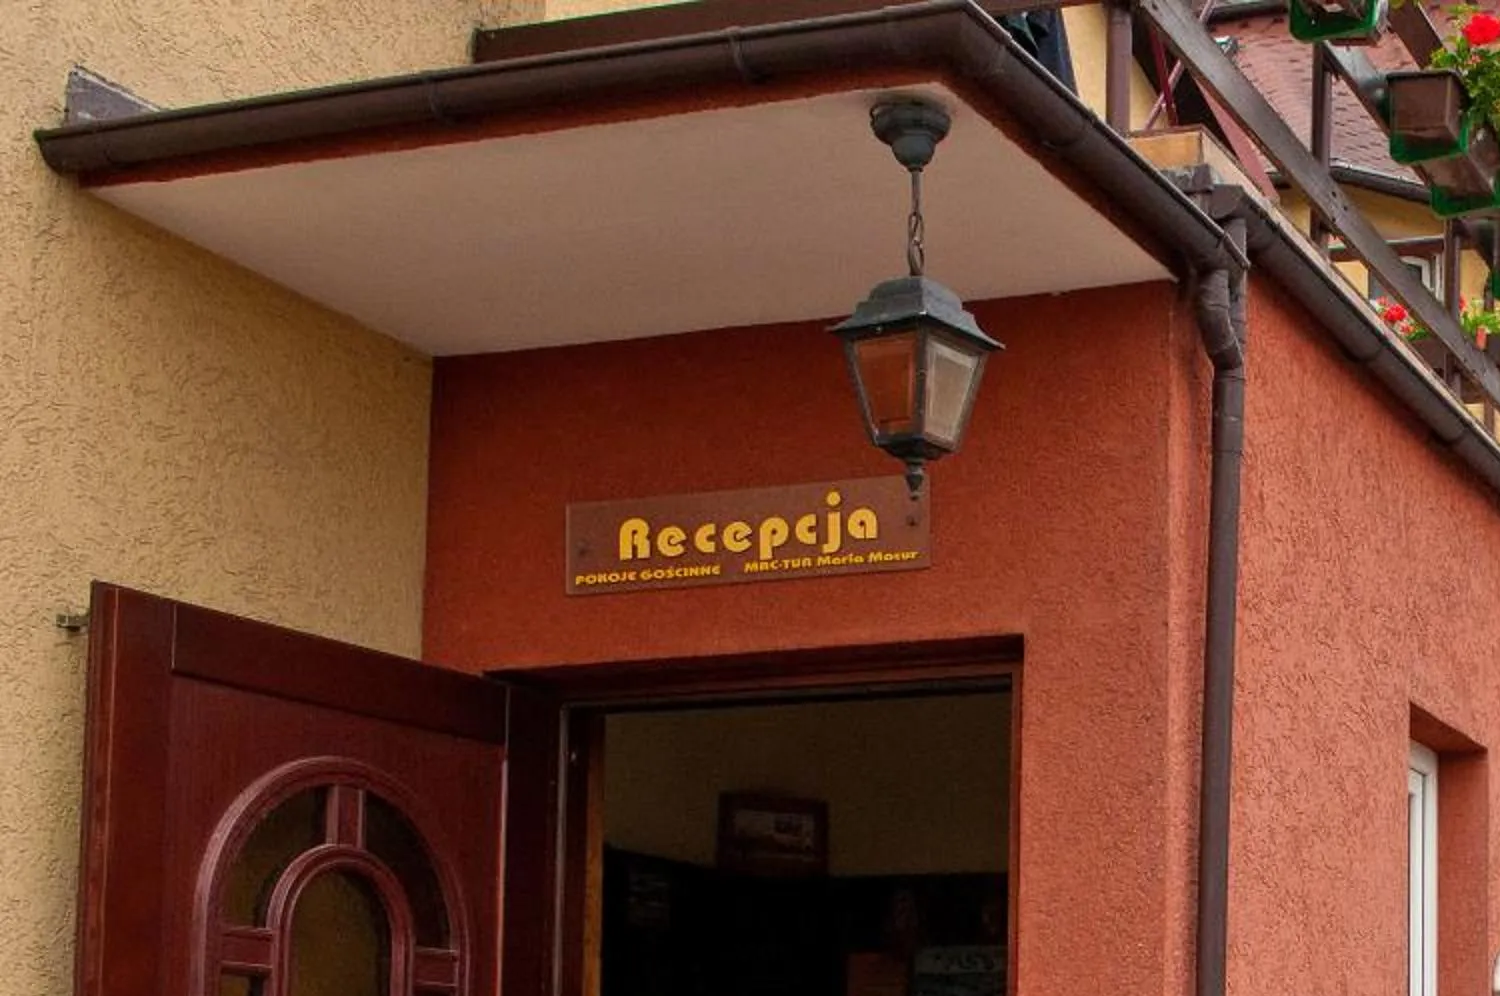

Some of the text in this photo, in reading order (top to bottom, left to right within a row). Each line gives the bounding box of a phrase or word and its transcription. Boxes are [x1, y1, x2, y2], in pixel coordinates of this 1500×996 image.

[618, 490, 878, 561] Recepcja
[817, 553, 864, 566] Maria
[575, 571, 637, 585] POKOJE
